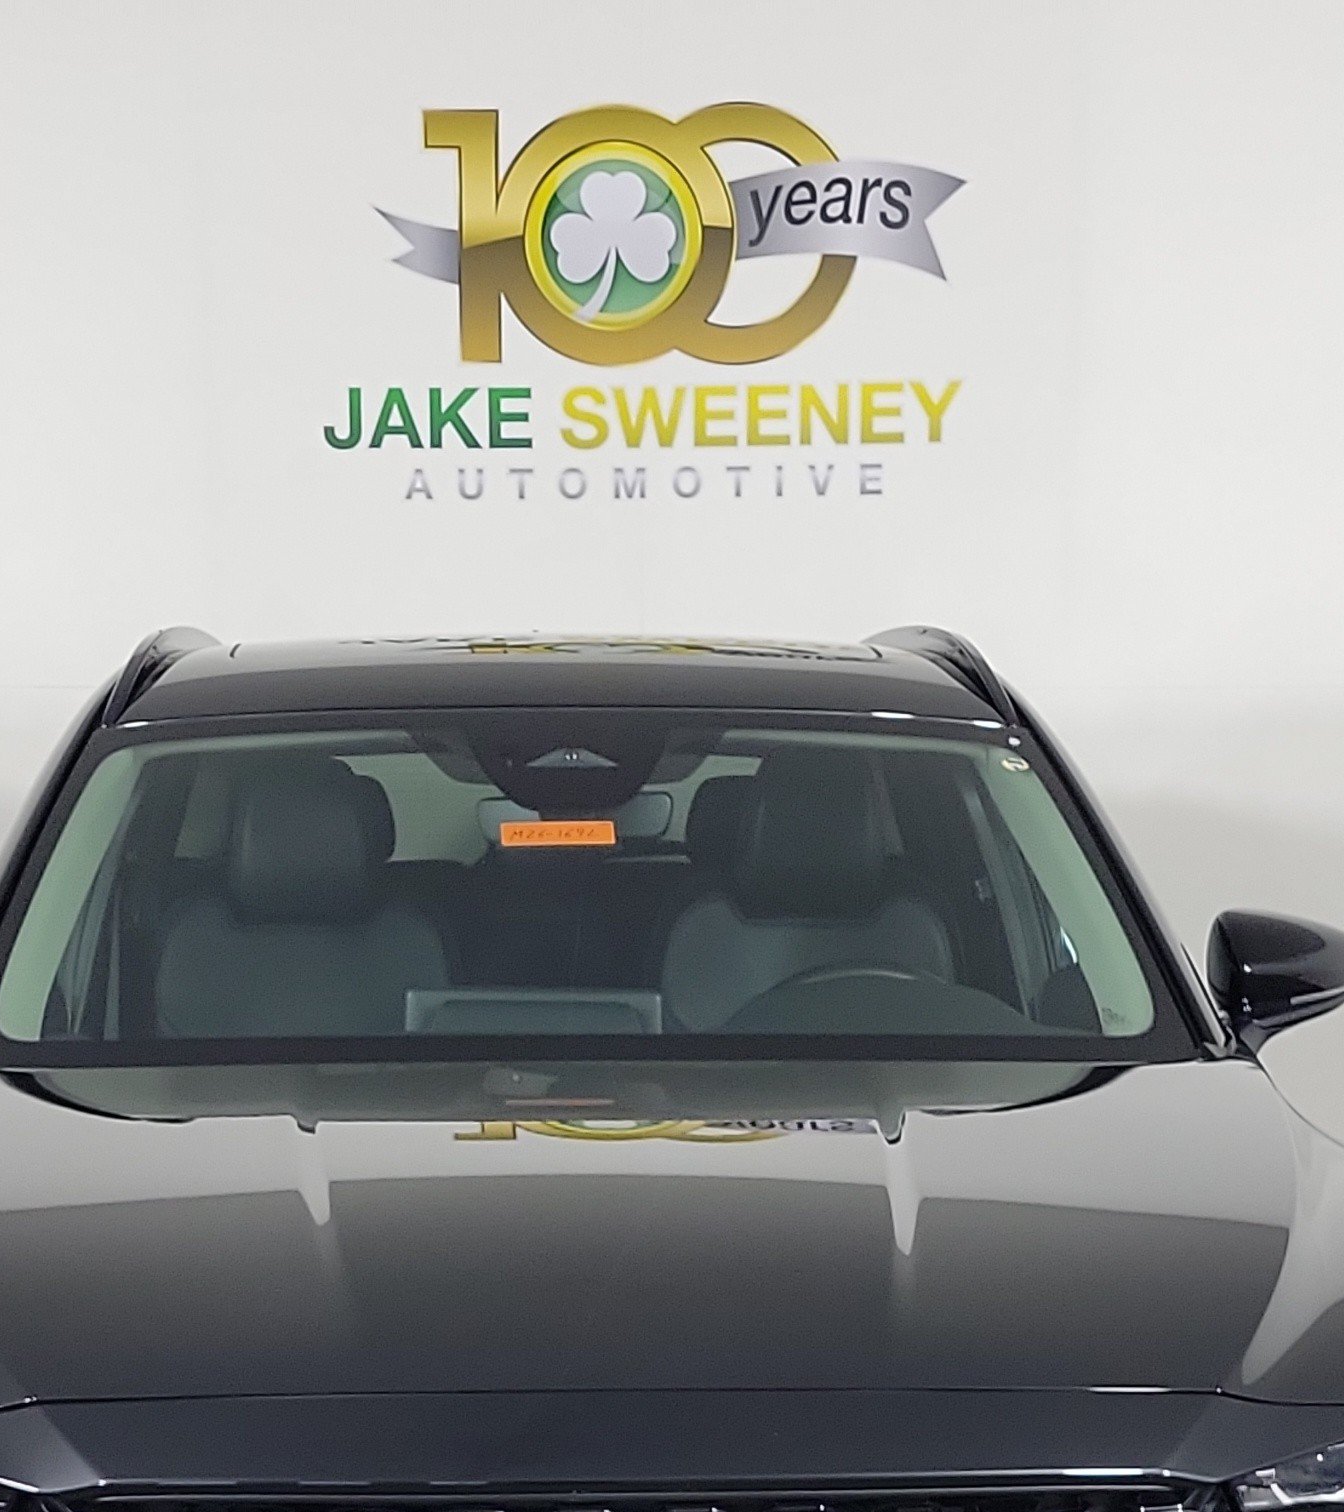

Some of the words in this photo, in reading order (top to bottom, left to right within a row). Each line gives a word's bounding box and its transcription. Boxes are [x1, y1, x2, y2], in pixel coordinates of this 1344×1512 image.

[422, 101, 858, 366] 100
[748, 174, 913, 247] years
[323, 386, 533, 450] JAKE
[560, 379, 963, 449] SWEENEY
[405, 462, 884, 501] AUTOMOTIVE
